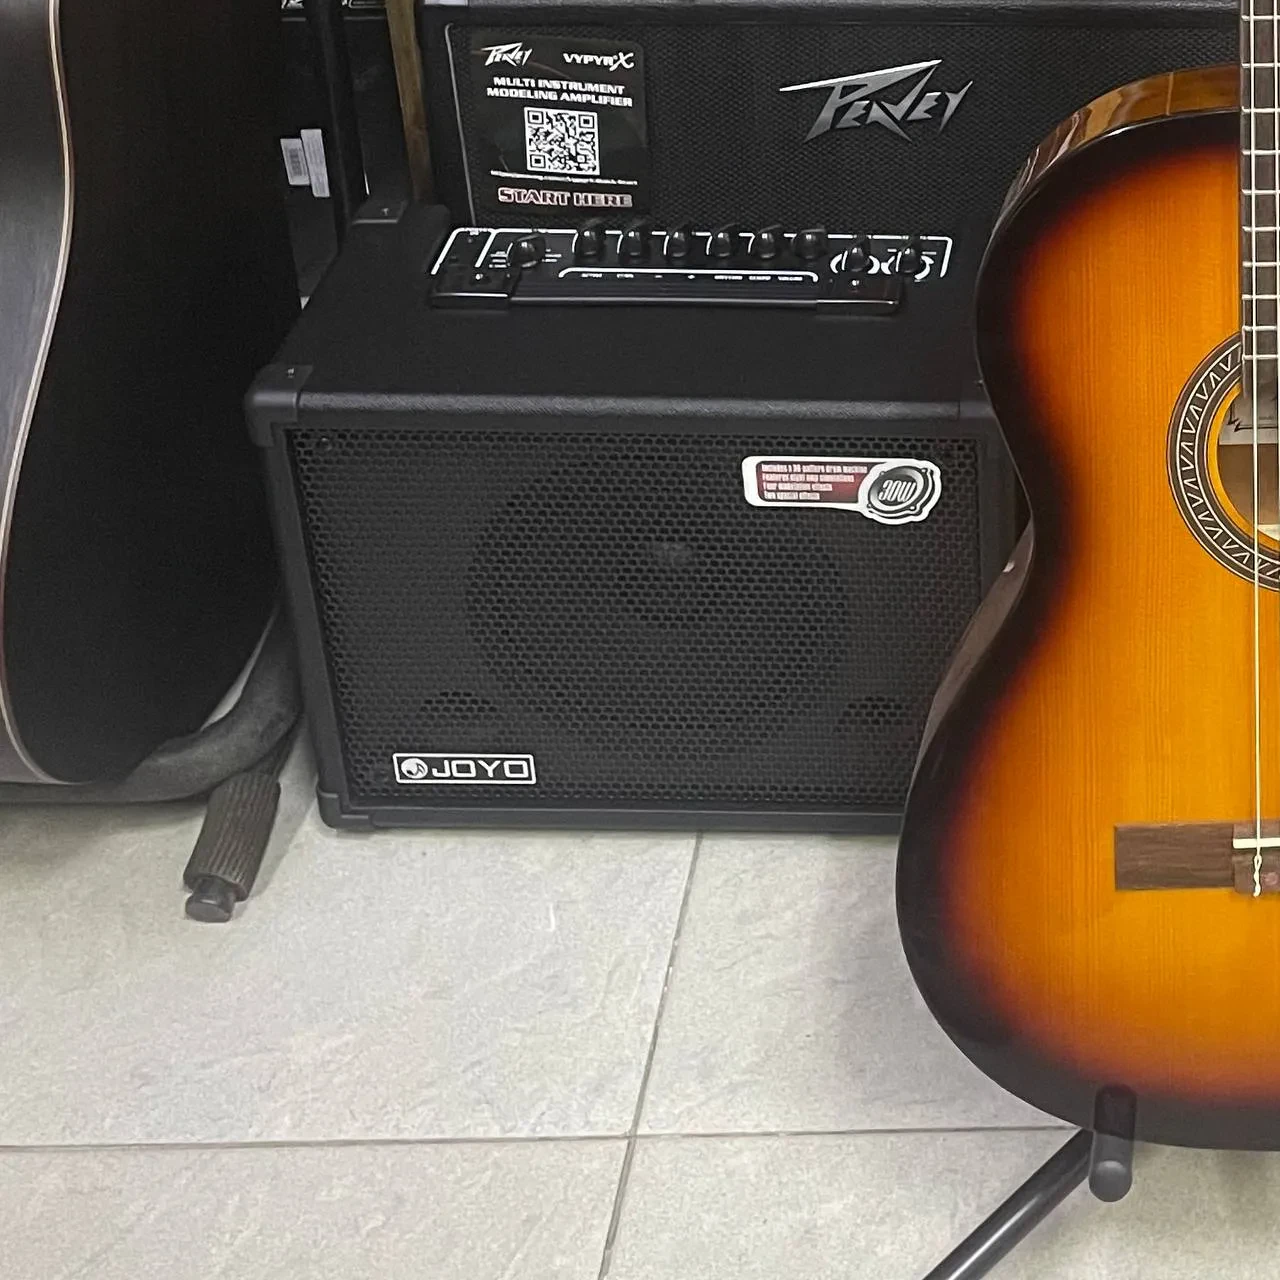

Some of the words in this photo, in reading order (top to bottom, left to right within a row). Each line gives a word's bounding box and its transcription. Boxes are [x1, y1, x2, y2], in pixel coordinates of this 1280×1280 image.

[493, 77, 535, 88] MULTI
[537, 79, 625, 95] INSTRUMENT
[487, 87, 558, 101] MODELING
[560, 92, 633, 107] AMPLIFIER
[498, 187, 571, 206] START
[573, 192, 633, 208] HERE
[879, 480, 917, 503] 30W
[432, 759, 529, 778] JOYO
